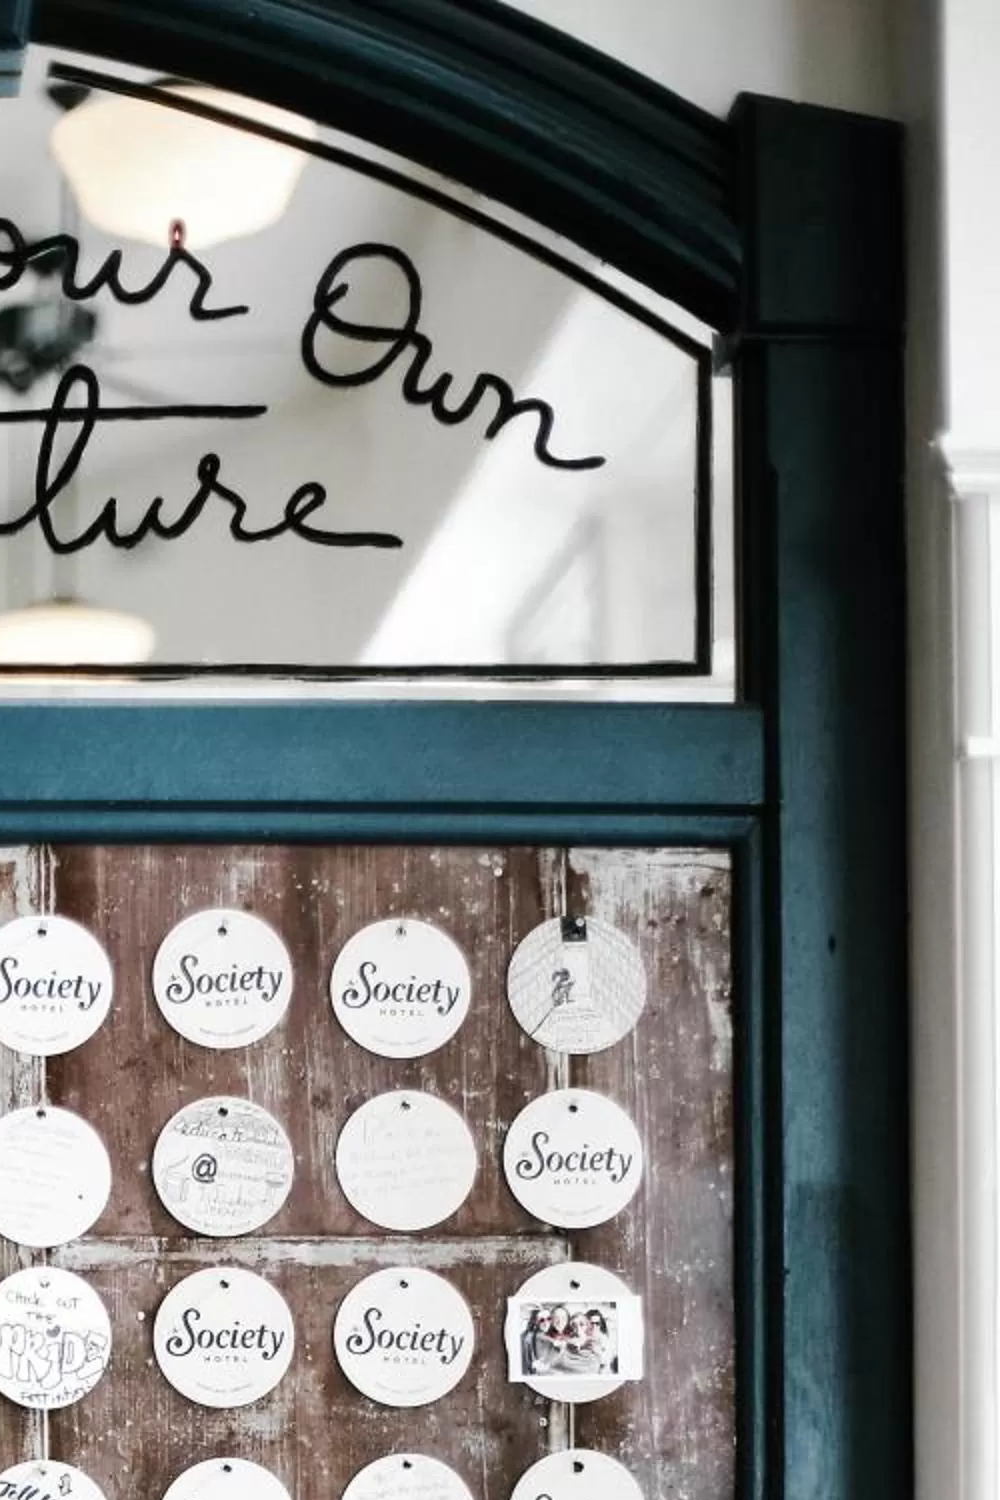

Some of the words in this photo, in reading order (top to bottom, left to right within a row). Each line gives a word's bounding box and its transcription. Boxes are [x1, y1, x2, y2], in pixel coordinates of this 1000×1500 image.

[302, 243, 605, 470] Own
[165, 954, 283, 1004] Society
[342, 962, 460, 1015] Society
[515, 1132, 632, 1183] Society
[166, 1308, 284, 1360] Society
[346, 1307, 464, 1365] Society
